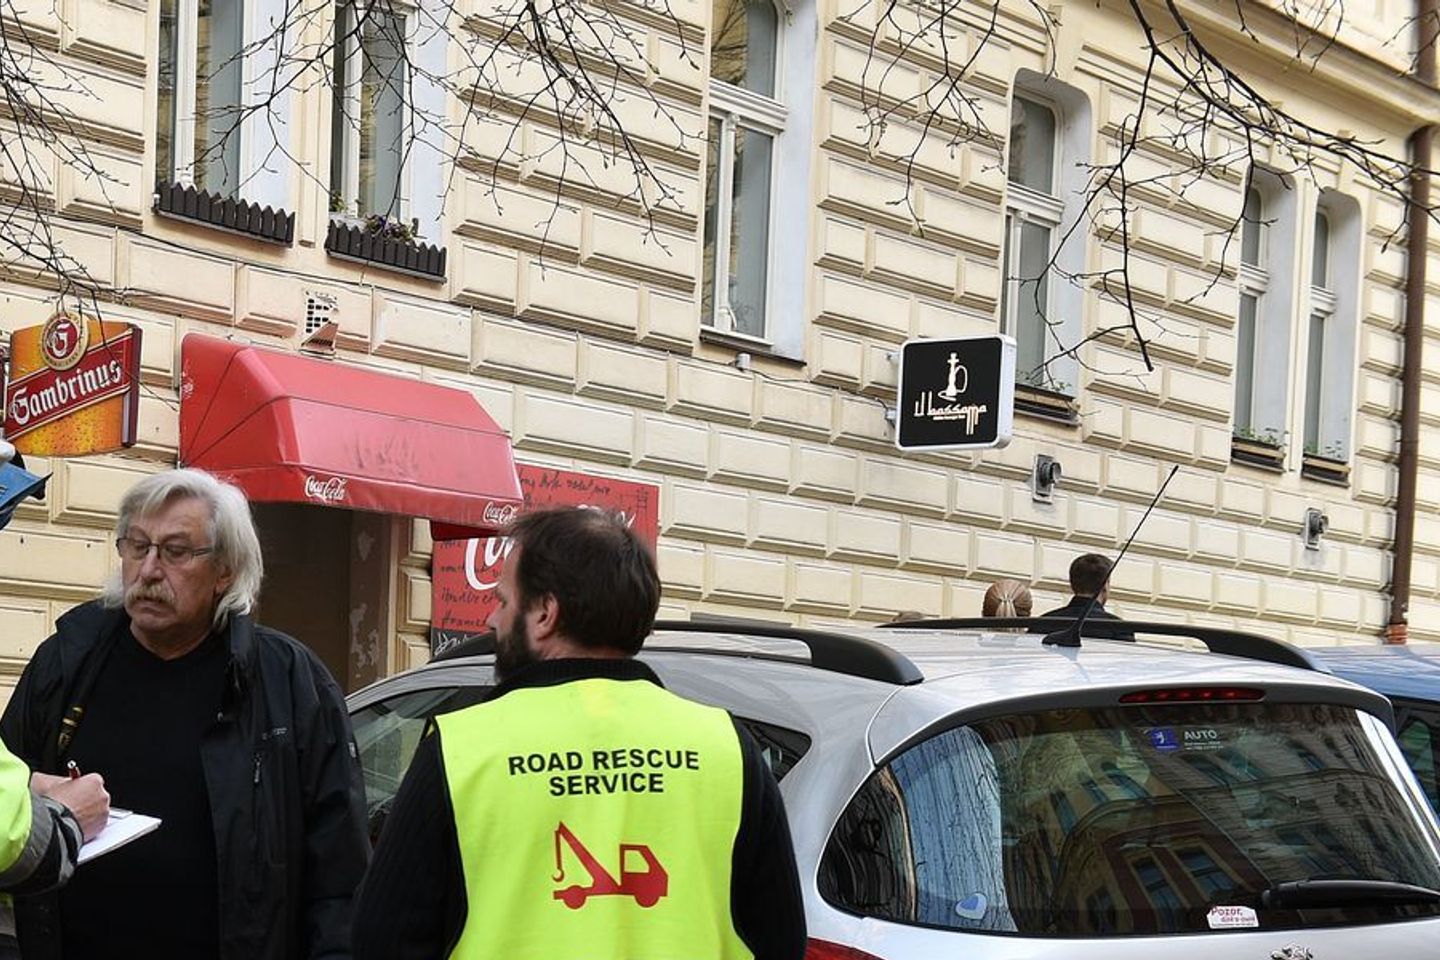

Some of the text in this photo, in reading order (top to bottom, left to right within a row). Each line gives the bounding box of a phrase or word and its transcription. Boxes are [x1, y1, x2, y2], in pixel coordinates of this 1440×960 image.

[11, 359, 122, 425] Gambrinus
[1184, 729, 1218, 740] AUTO
[509, 749, 699, 776] ROAD RESCUE
[549, 772, 664, 796] SERVICE
